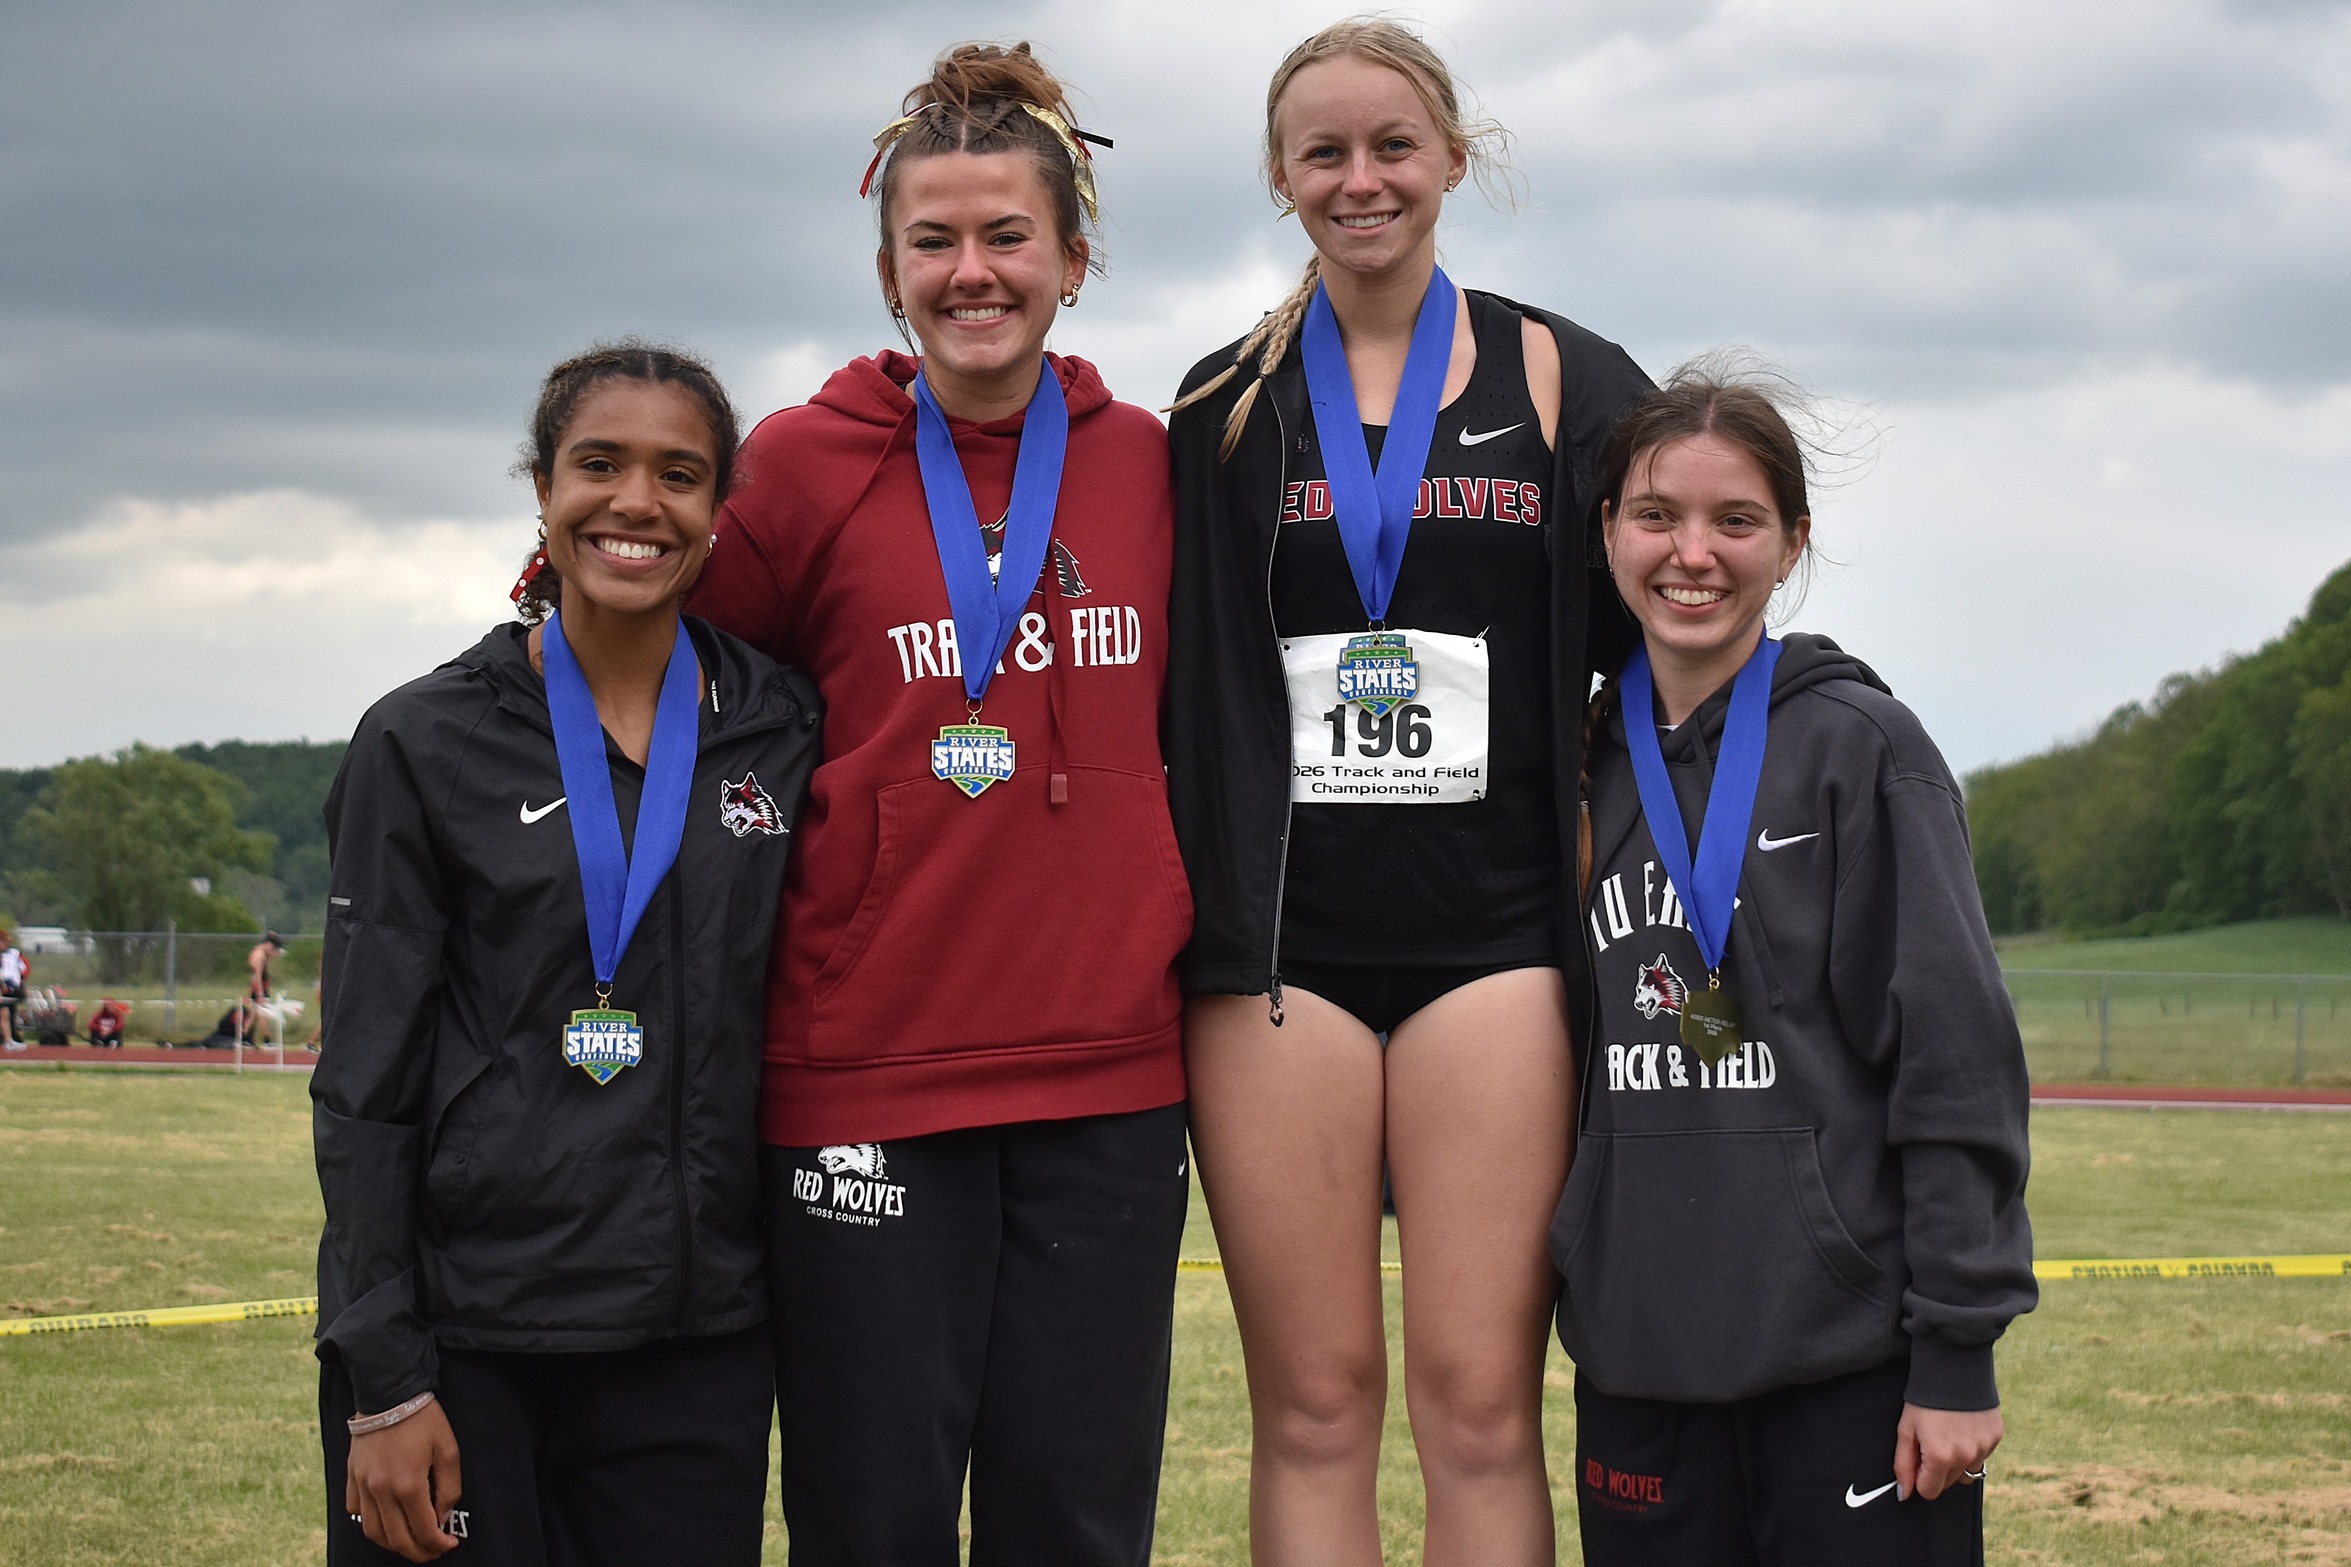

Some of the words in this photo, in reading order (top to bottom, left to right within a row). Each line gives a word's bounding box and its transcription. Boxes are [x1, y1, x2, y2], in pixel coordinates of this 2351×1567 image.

[1281, 480, 1334, 523] ED
[887, 619, 1005, 683] TRA
[1014, 612, 1055, 672] &
[1069, 605, 1141, 666] FIELD
[1354, 659, 1402, 669] RIVER
[1340, 667, 1416, 693] STATES
[1349, 688, 1408, 698] CONFERENCE
[950, 737, 998, 747] RIVER
[1323, 704, 1432, 758] 196
[934, 747, 1012, 771] STATES
[943, 766, 1004, 776] CONFERENCE
[1332, 766, 1384, 778] Track
[1392, 767, 1425, 778] and
[1434, 767, 1479, 778] Field
[1311, 783, 1440, 797] Championship
[582, 1022, 627, 1032] RIVER
[566, 1032, 640, 1057] STATES
[575, 1053, 632, 1062] CONFERENCE
[1607, 1044, 1662, 1091] ACK
[1666, 1045, 1689, 1087] &
[793, 1168, 823, 1202] RED
[832, 1176, 906, 1217] WOLVES
[806, 1206, 833, 1219] CROSS
[835, 1212, 881, 1227] COUNTRY
[1586, 1458, 1603, 1489] RED
[1609, 1469, 1663, 1503] WOLVES
